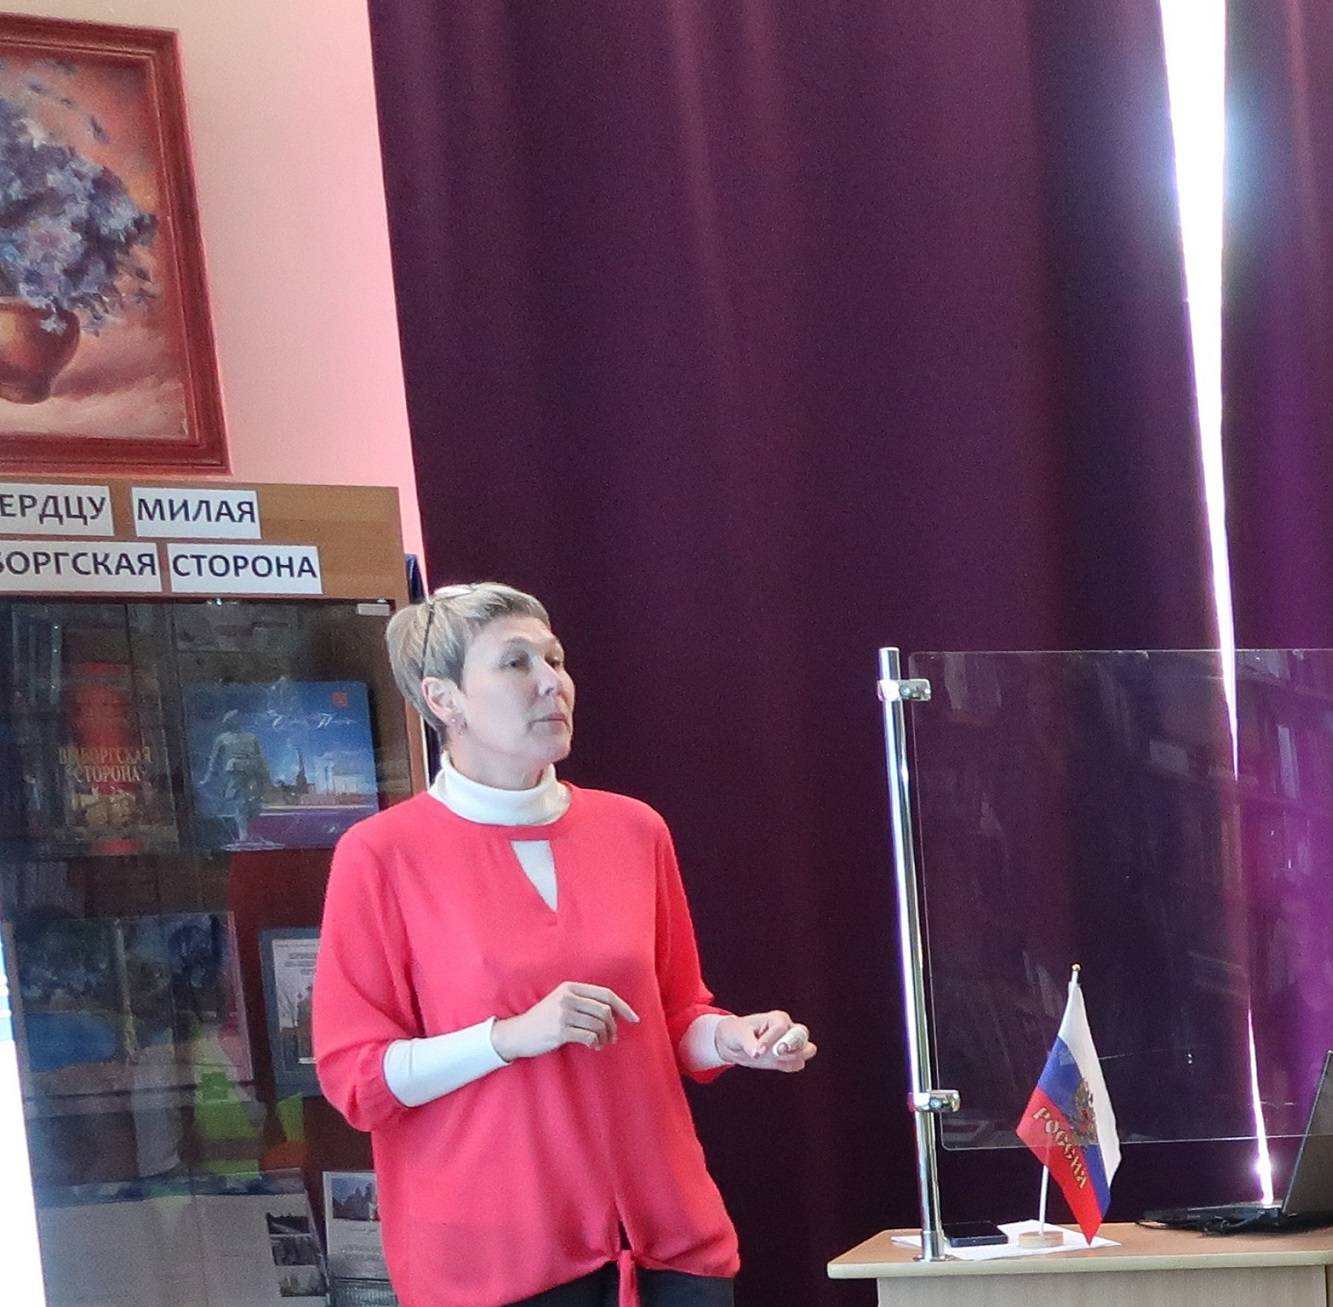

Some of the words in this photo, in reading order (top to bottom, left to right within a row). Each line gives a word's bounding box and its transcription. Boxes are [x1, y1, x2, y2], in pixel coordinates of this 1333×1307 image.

[137, 497, 257, 524] МИЛАЯ
[172, 552, 318, 580] СТОРОНА
[58, 745, 152, 767] ВЫБОРГСКАЯ
[74, 763, 142, 784] СТОРОНА
